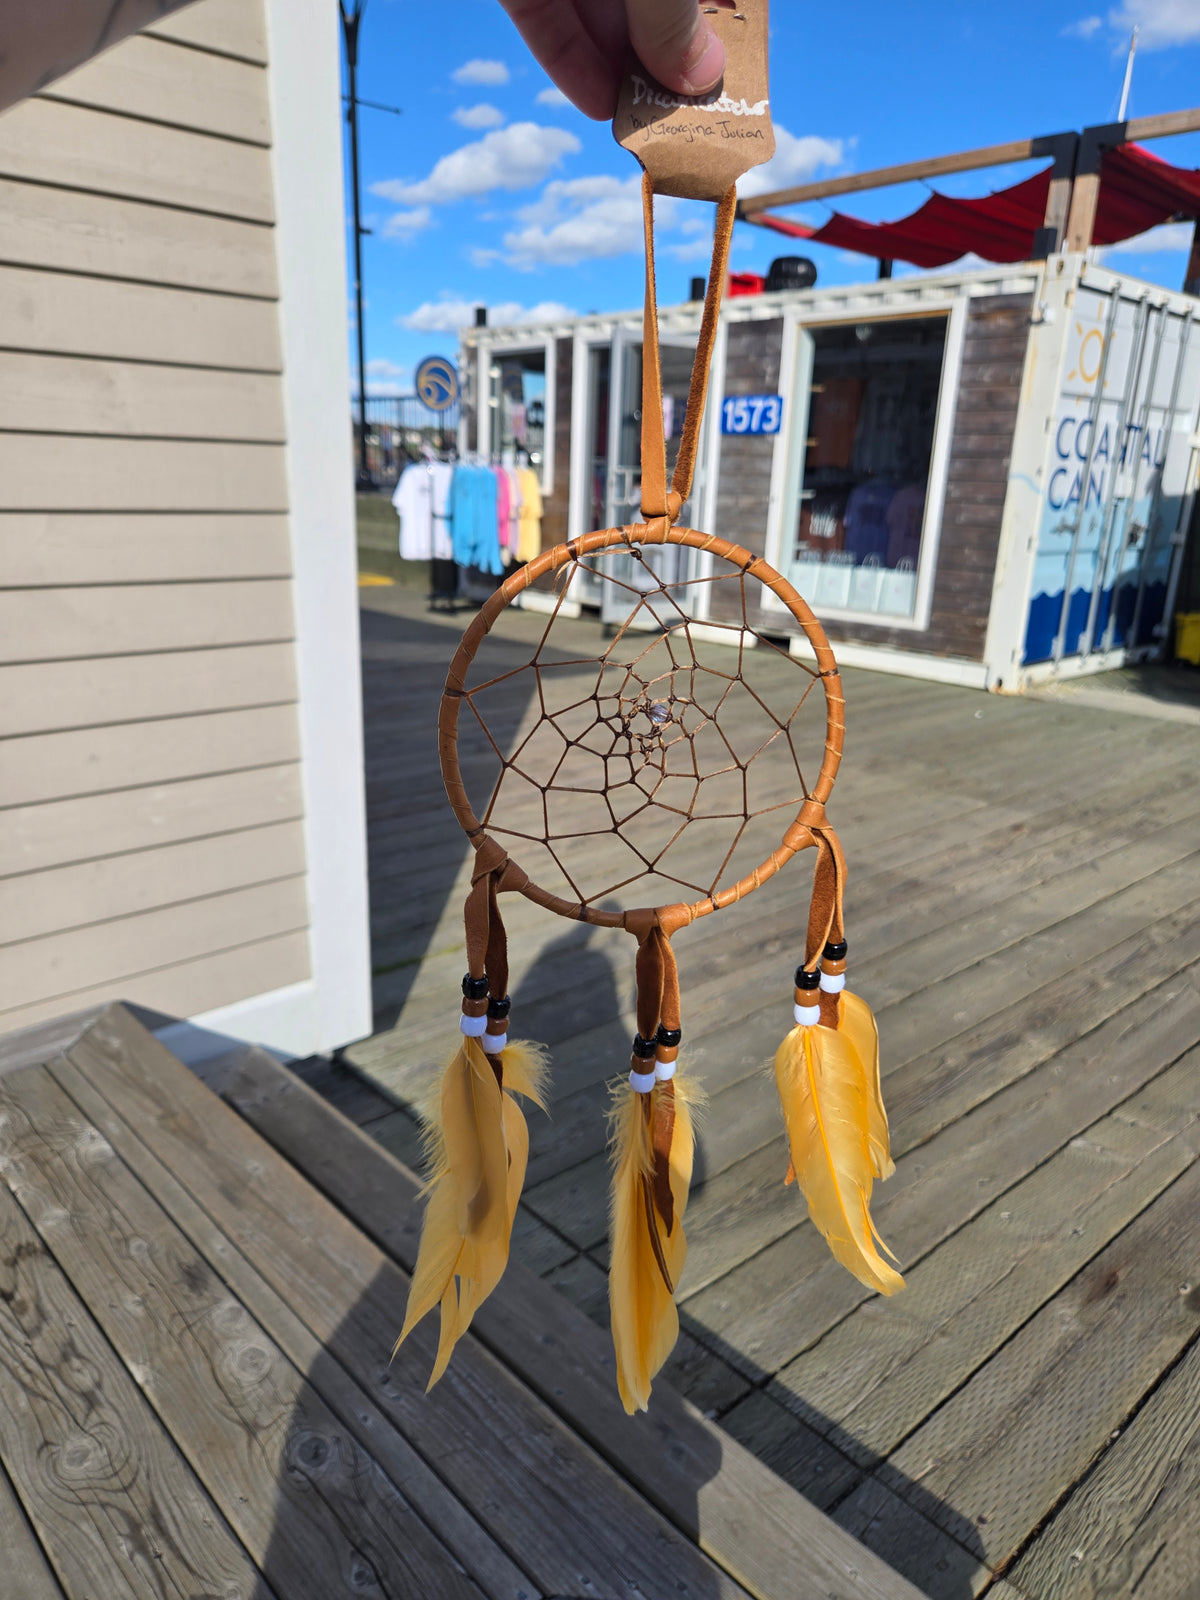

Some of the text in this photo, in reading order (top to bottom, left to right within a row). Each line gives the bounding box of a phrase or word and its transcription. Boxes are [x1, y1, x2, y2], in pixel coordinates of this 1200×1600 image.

[631, 114, 764, 142] by Georgina Julian
[723, 398, 780, 432] 1573
